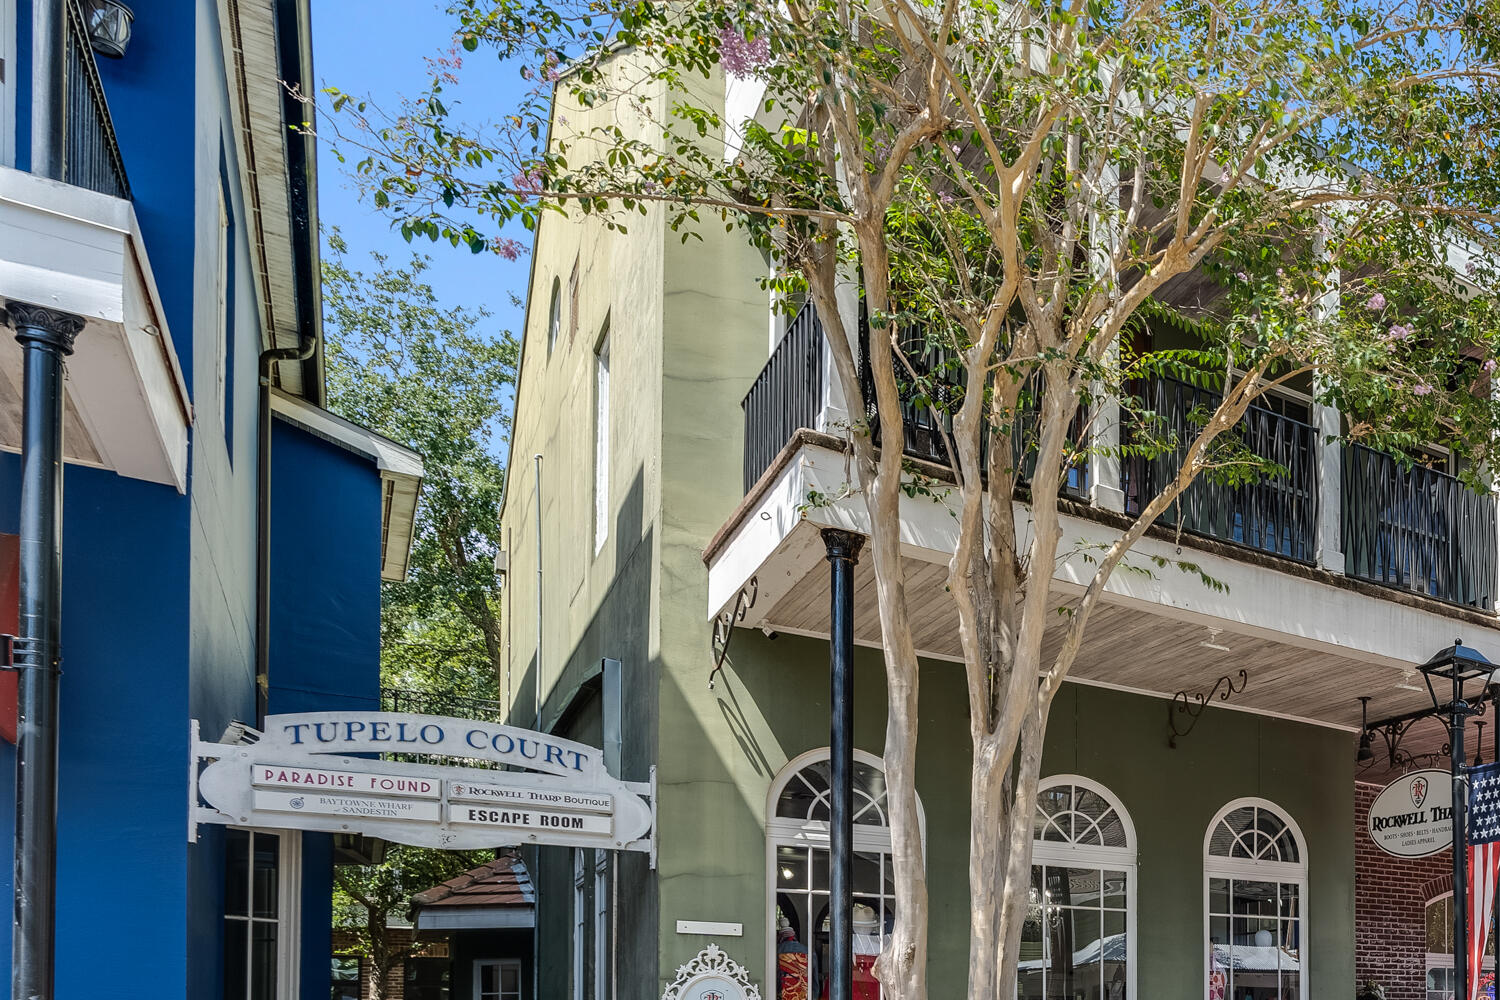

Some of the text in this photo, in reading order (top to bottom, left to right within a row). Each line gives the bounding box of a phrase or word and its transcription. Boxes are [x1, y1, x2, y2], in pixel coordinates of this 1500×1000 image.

[283, 721, 589, 773] TUPELO COURT
[264, 769, 432, 793] PARADISE FOUND
[319, 797, 414, 811] BAYTOWNE WHARF
[468, 786, 610, 807] ROCKWELL THARP BOUTIQUE
[342, 807, 398, 817] SANDESTIN
[468, 809, 584, 829] ESCAPE ROOM
[1372, 811, 1427, 832] ROCKWELL
